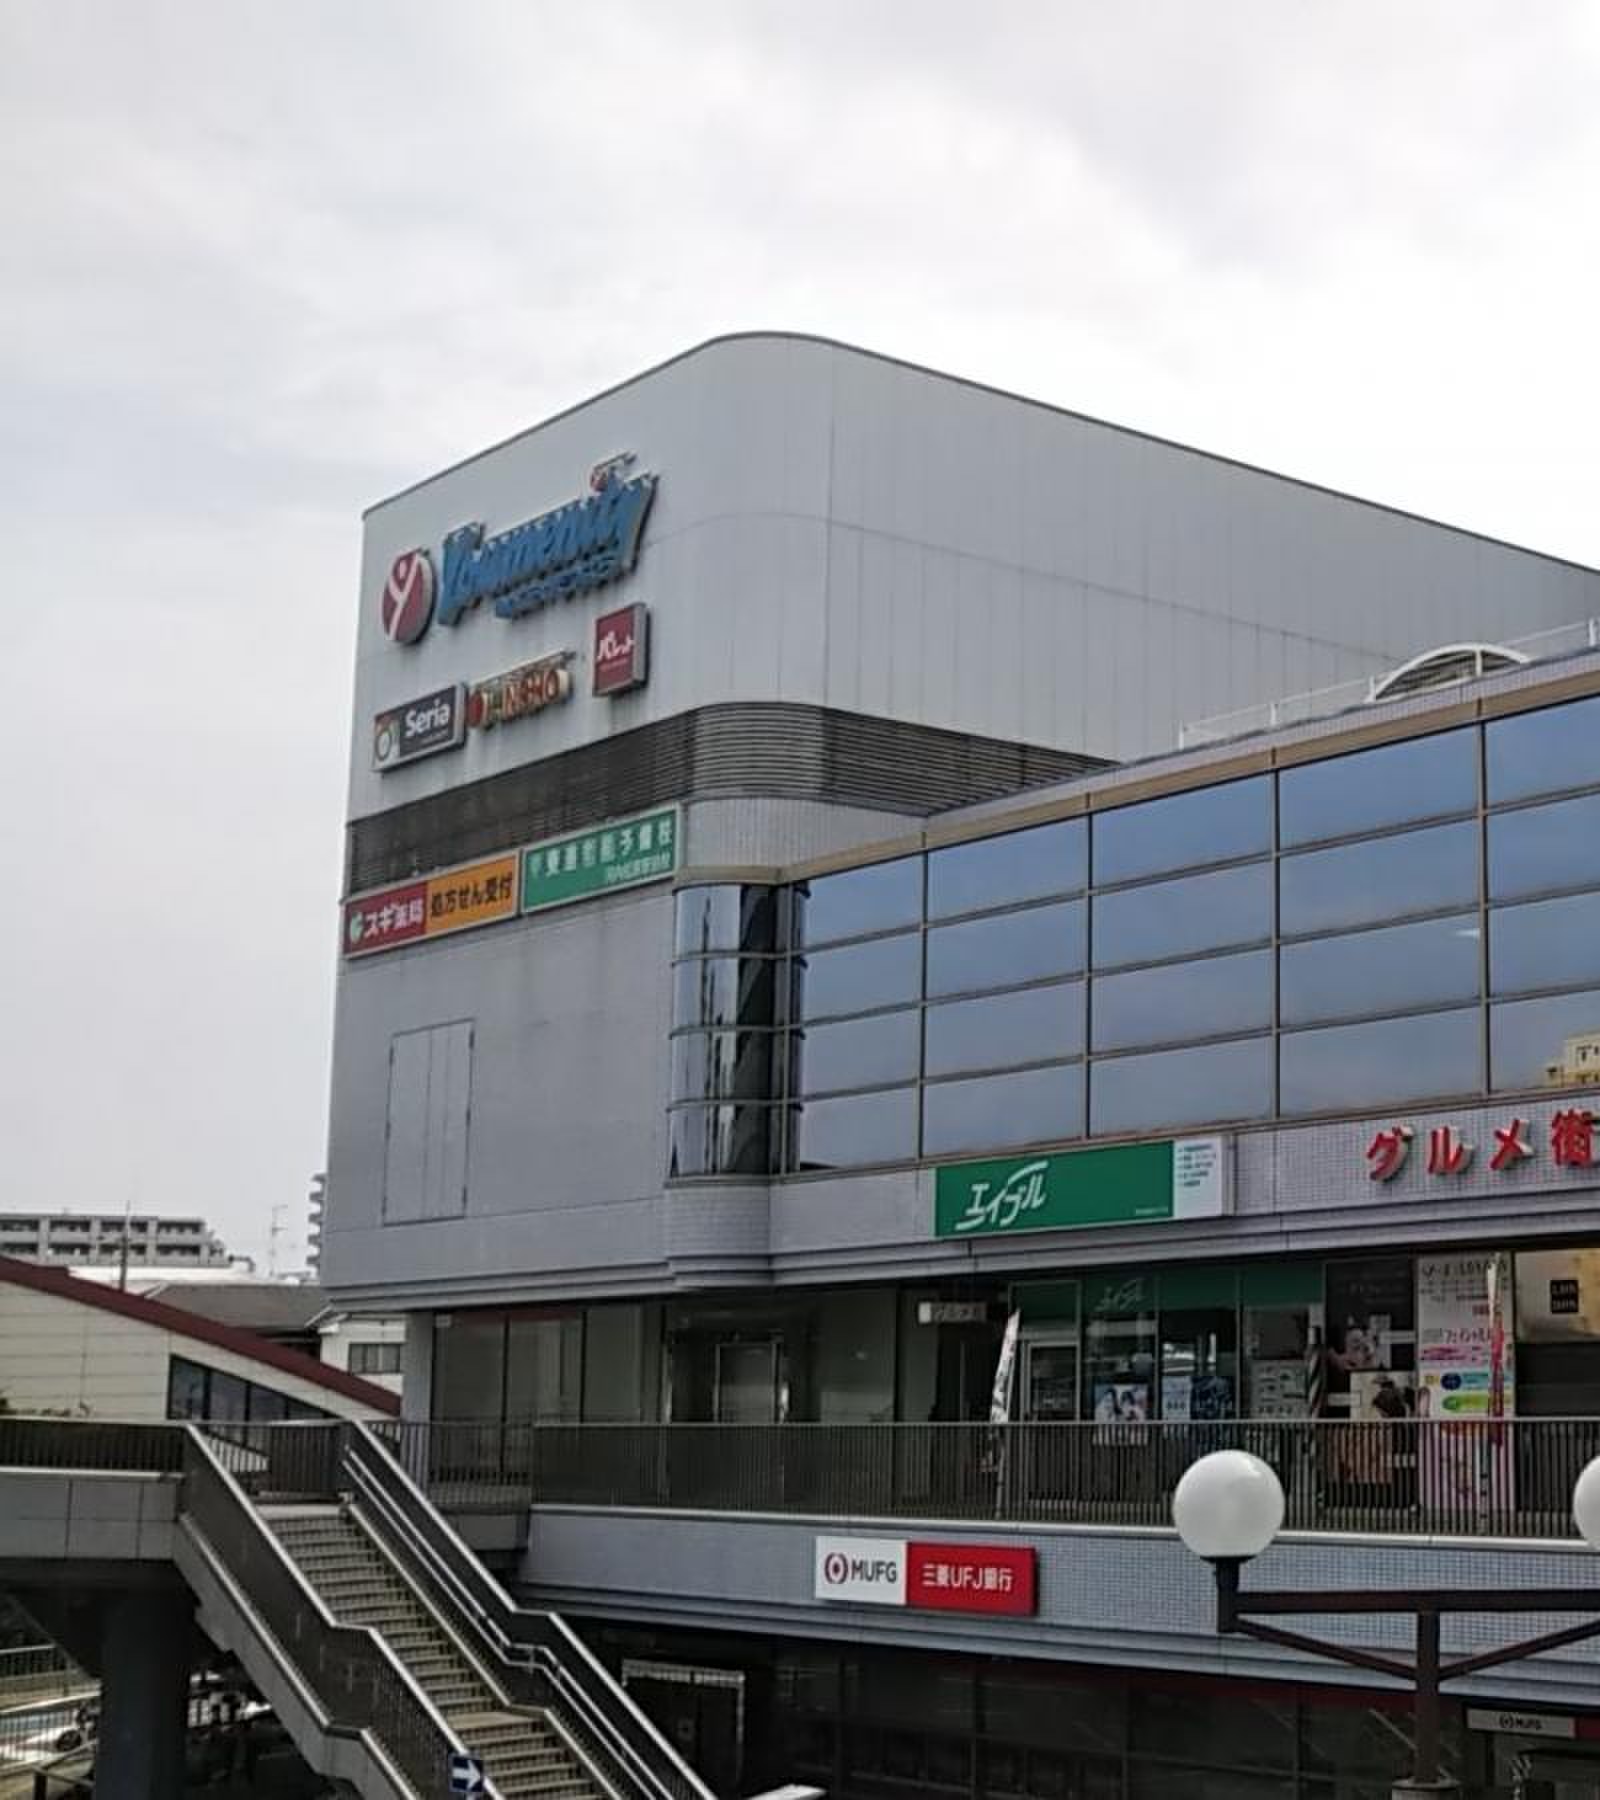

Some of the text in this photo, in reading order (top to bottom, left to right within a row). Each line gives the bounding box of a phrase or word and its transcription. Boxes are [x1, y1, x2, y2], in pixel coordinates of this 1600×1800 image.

[405, 699, 451, 737] Seria
[363, 899, 424, 939] スギ薬局
[955, 1160, 1049, 1231] エイブル
[851, 1559, 897, 1584] MUFG
[922, 1563, 1014, 1593] 三菱UFJ銀行
